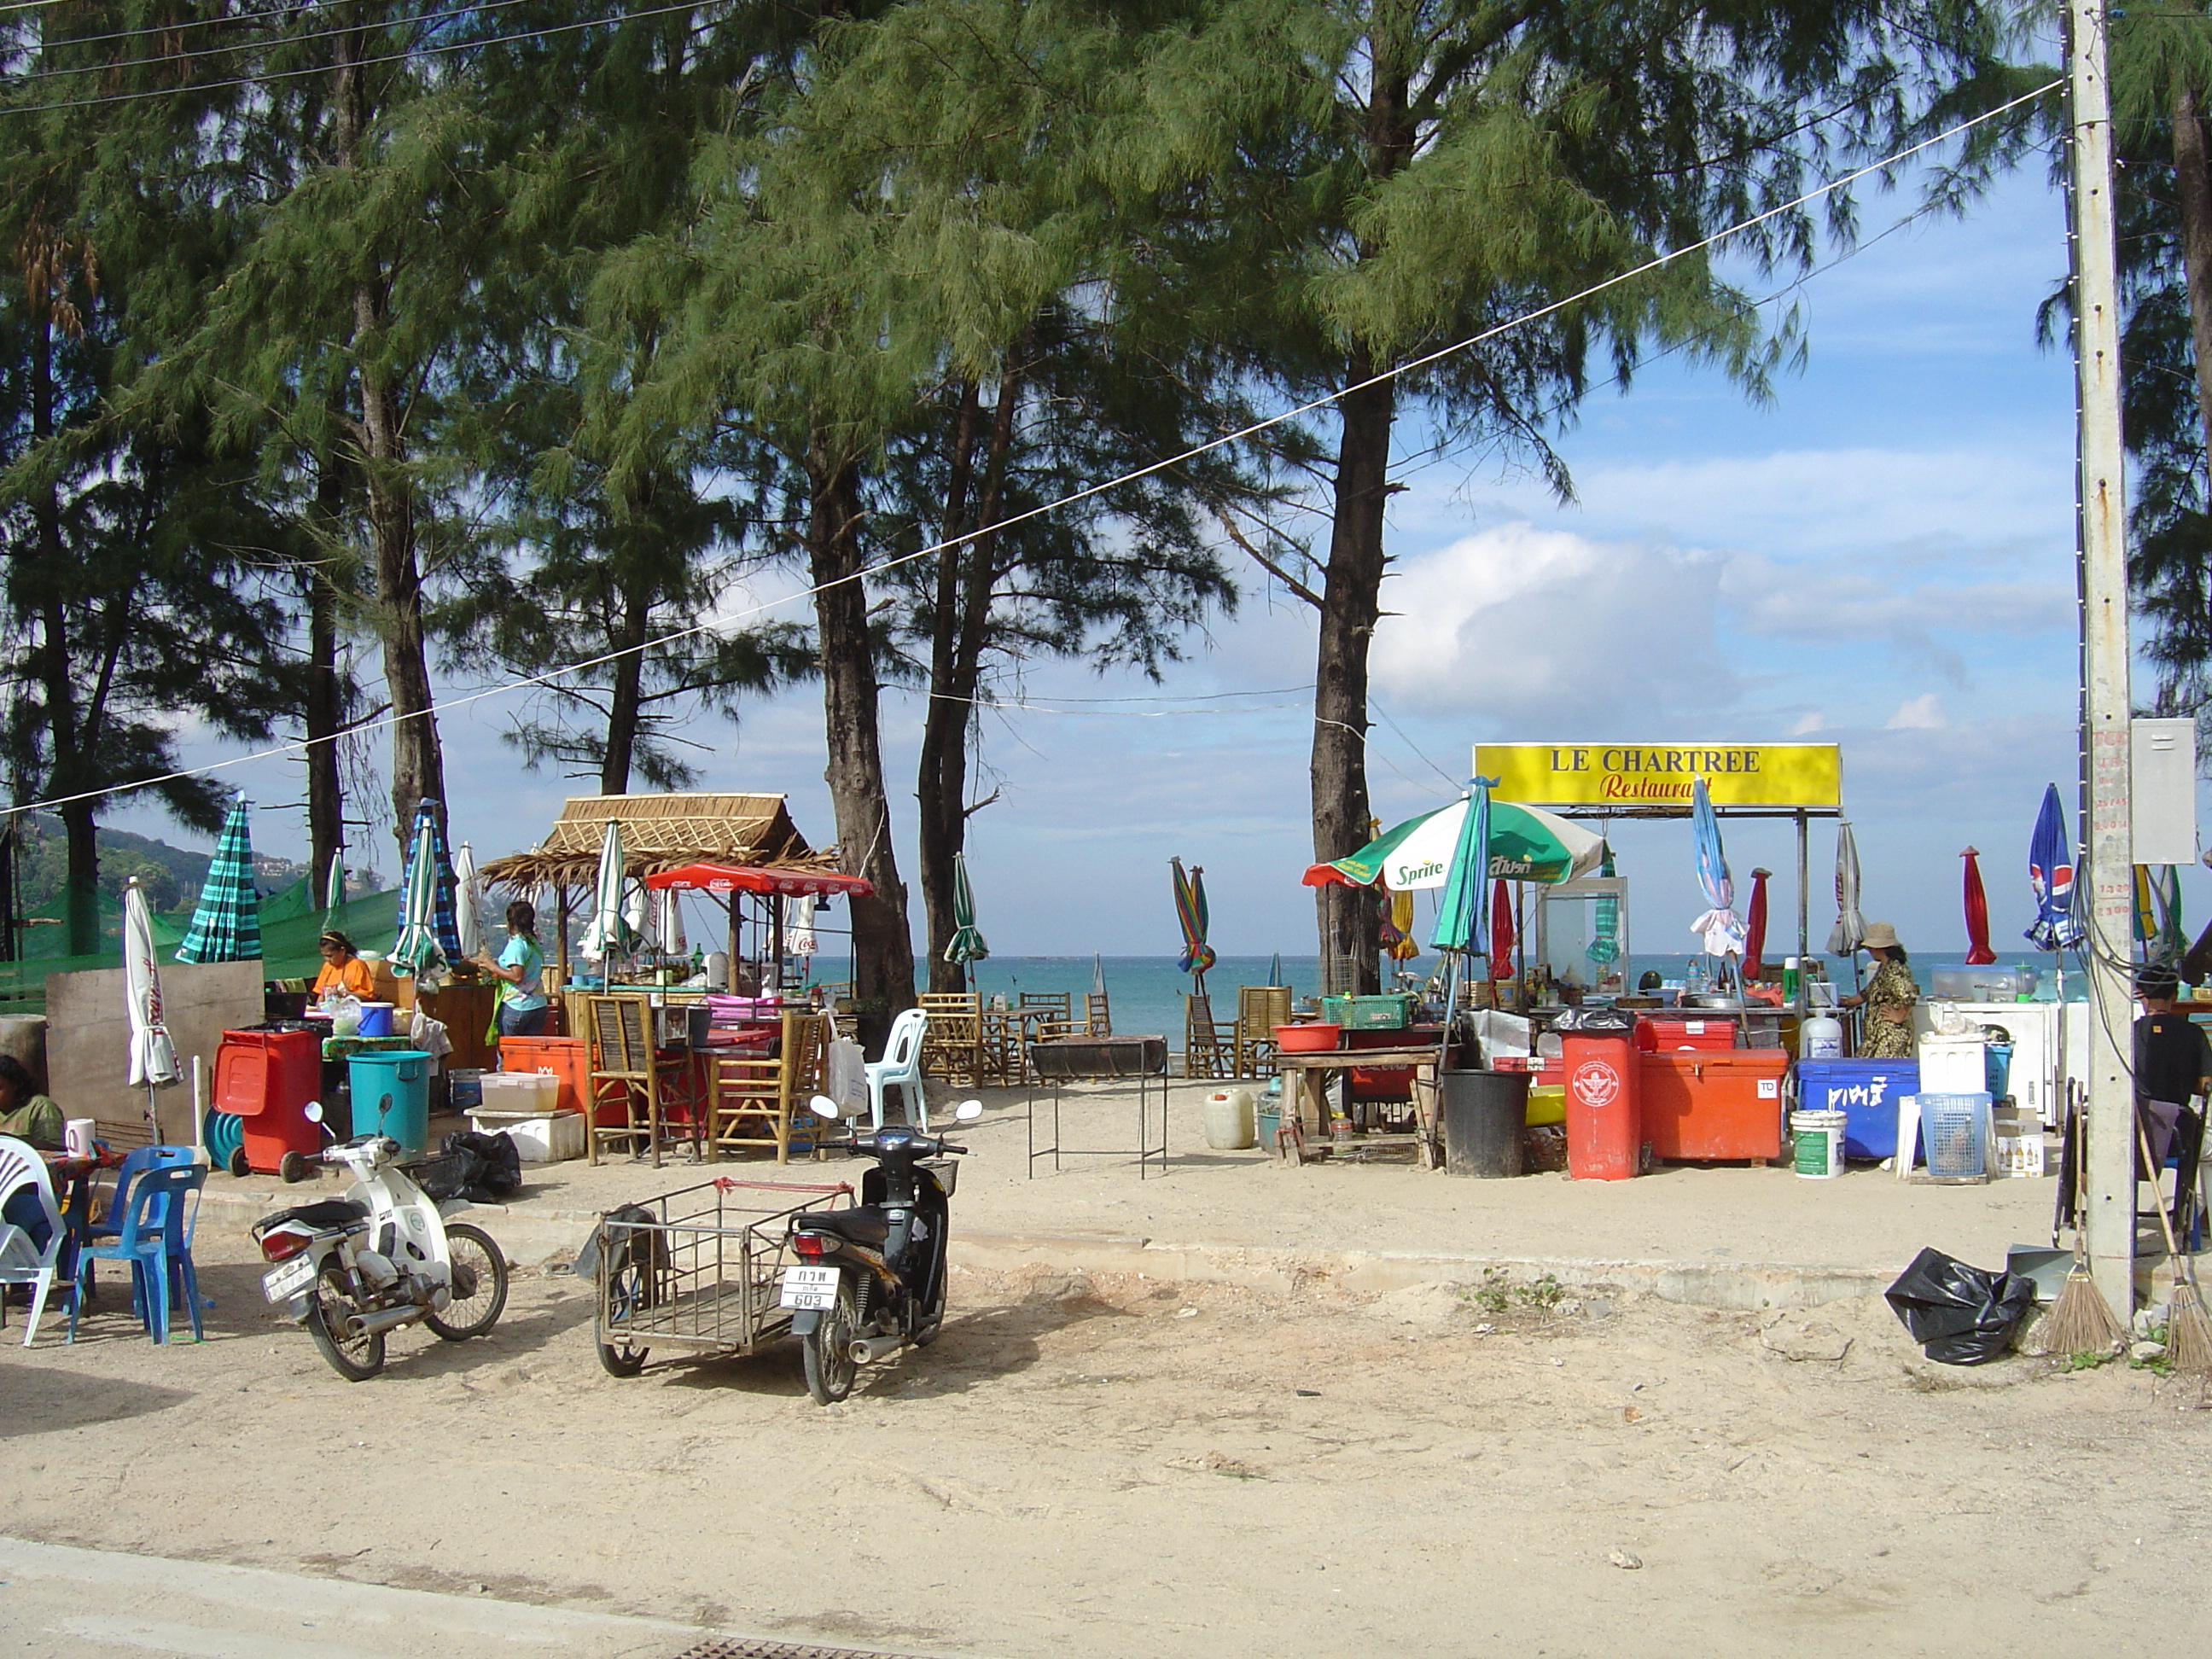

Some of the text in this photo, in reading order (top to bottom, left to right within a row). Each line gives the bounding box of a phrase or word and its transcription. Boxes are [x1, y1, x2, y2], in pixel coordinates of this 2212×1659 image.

[1551, 749, 1761, 772] LE CHARTREE
[1600, 774, 1712, 797] Restaurat
[1396, 861, 1443, 885] Sprite
[795, 1295, 822, 1307] 603
